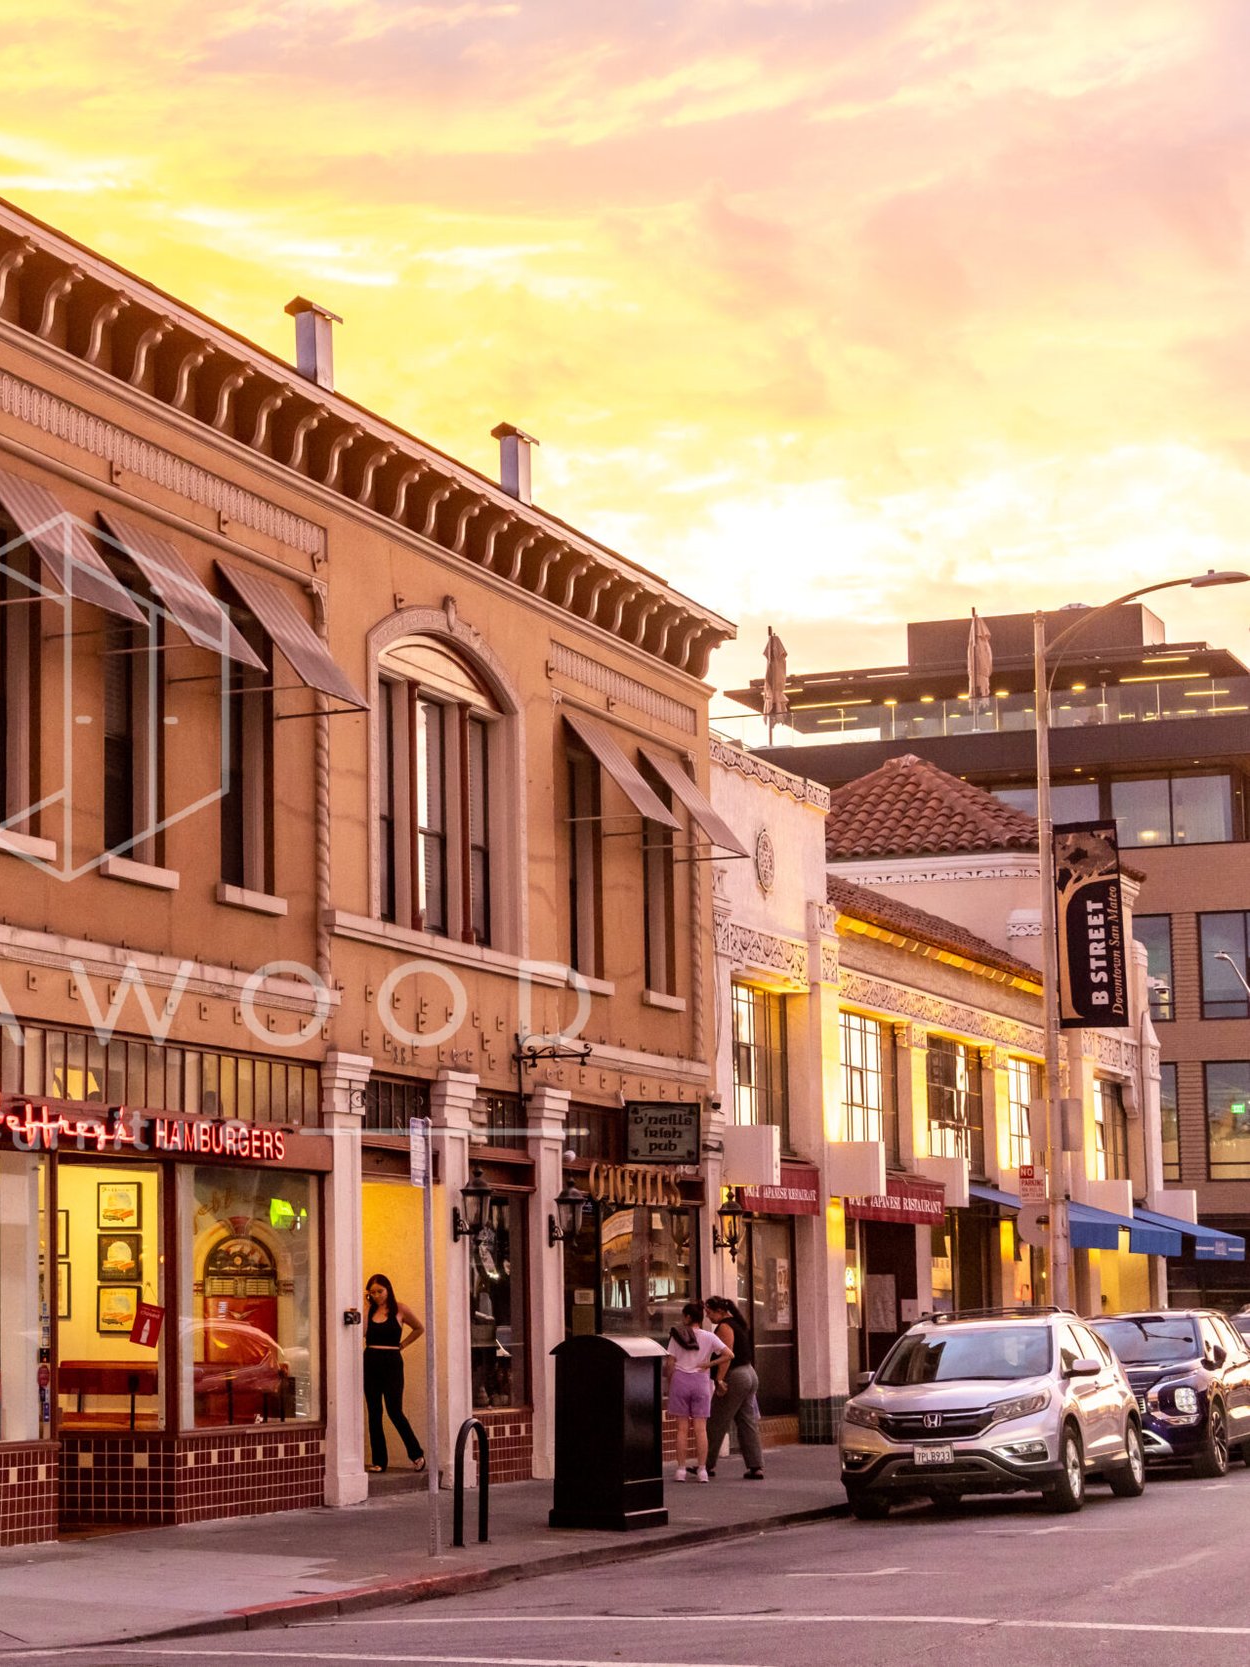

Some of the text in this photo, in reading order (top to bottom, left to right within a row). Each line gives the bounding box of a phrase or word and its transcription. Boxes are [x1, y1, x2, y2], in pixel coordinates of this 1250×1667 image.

[1086, 900, 1109, 1005] B STREET
[1106, 886, 1124, 1016] Downtown San Mateo
[155, 1117, 286, 1160] HAMBURGERS
[648, 1140, 678, 1154] pub
[589, 1161, 682, 1207] O'NEILL'S
[1021, 1168, 1033, 1177] NO
[902, 1197, 942, 1214] RESTAURANT
